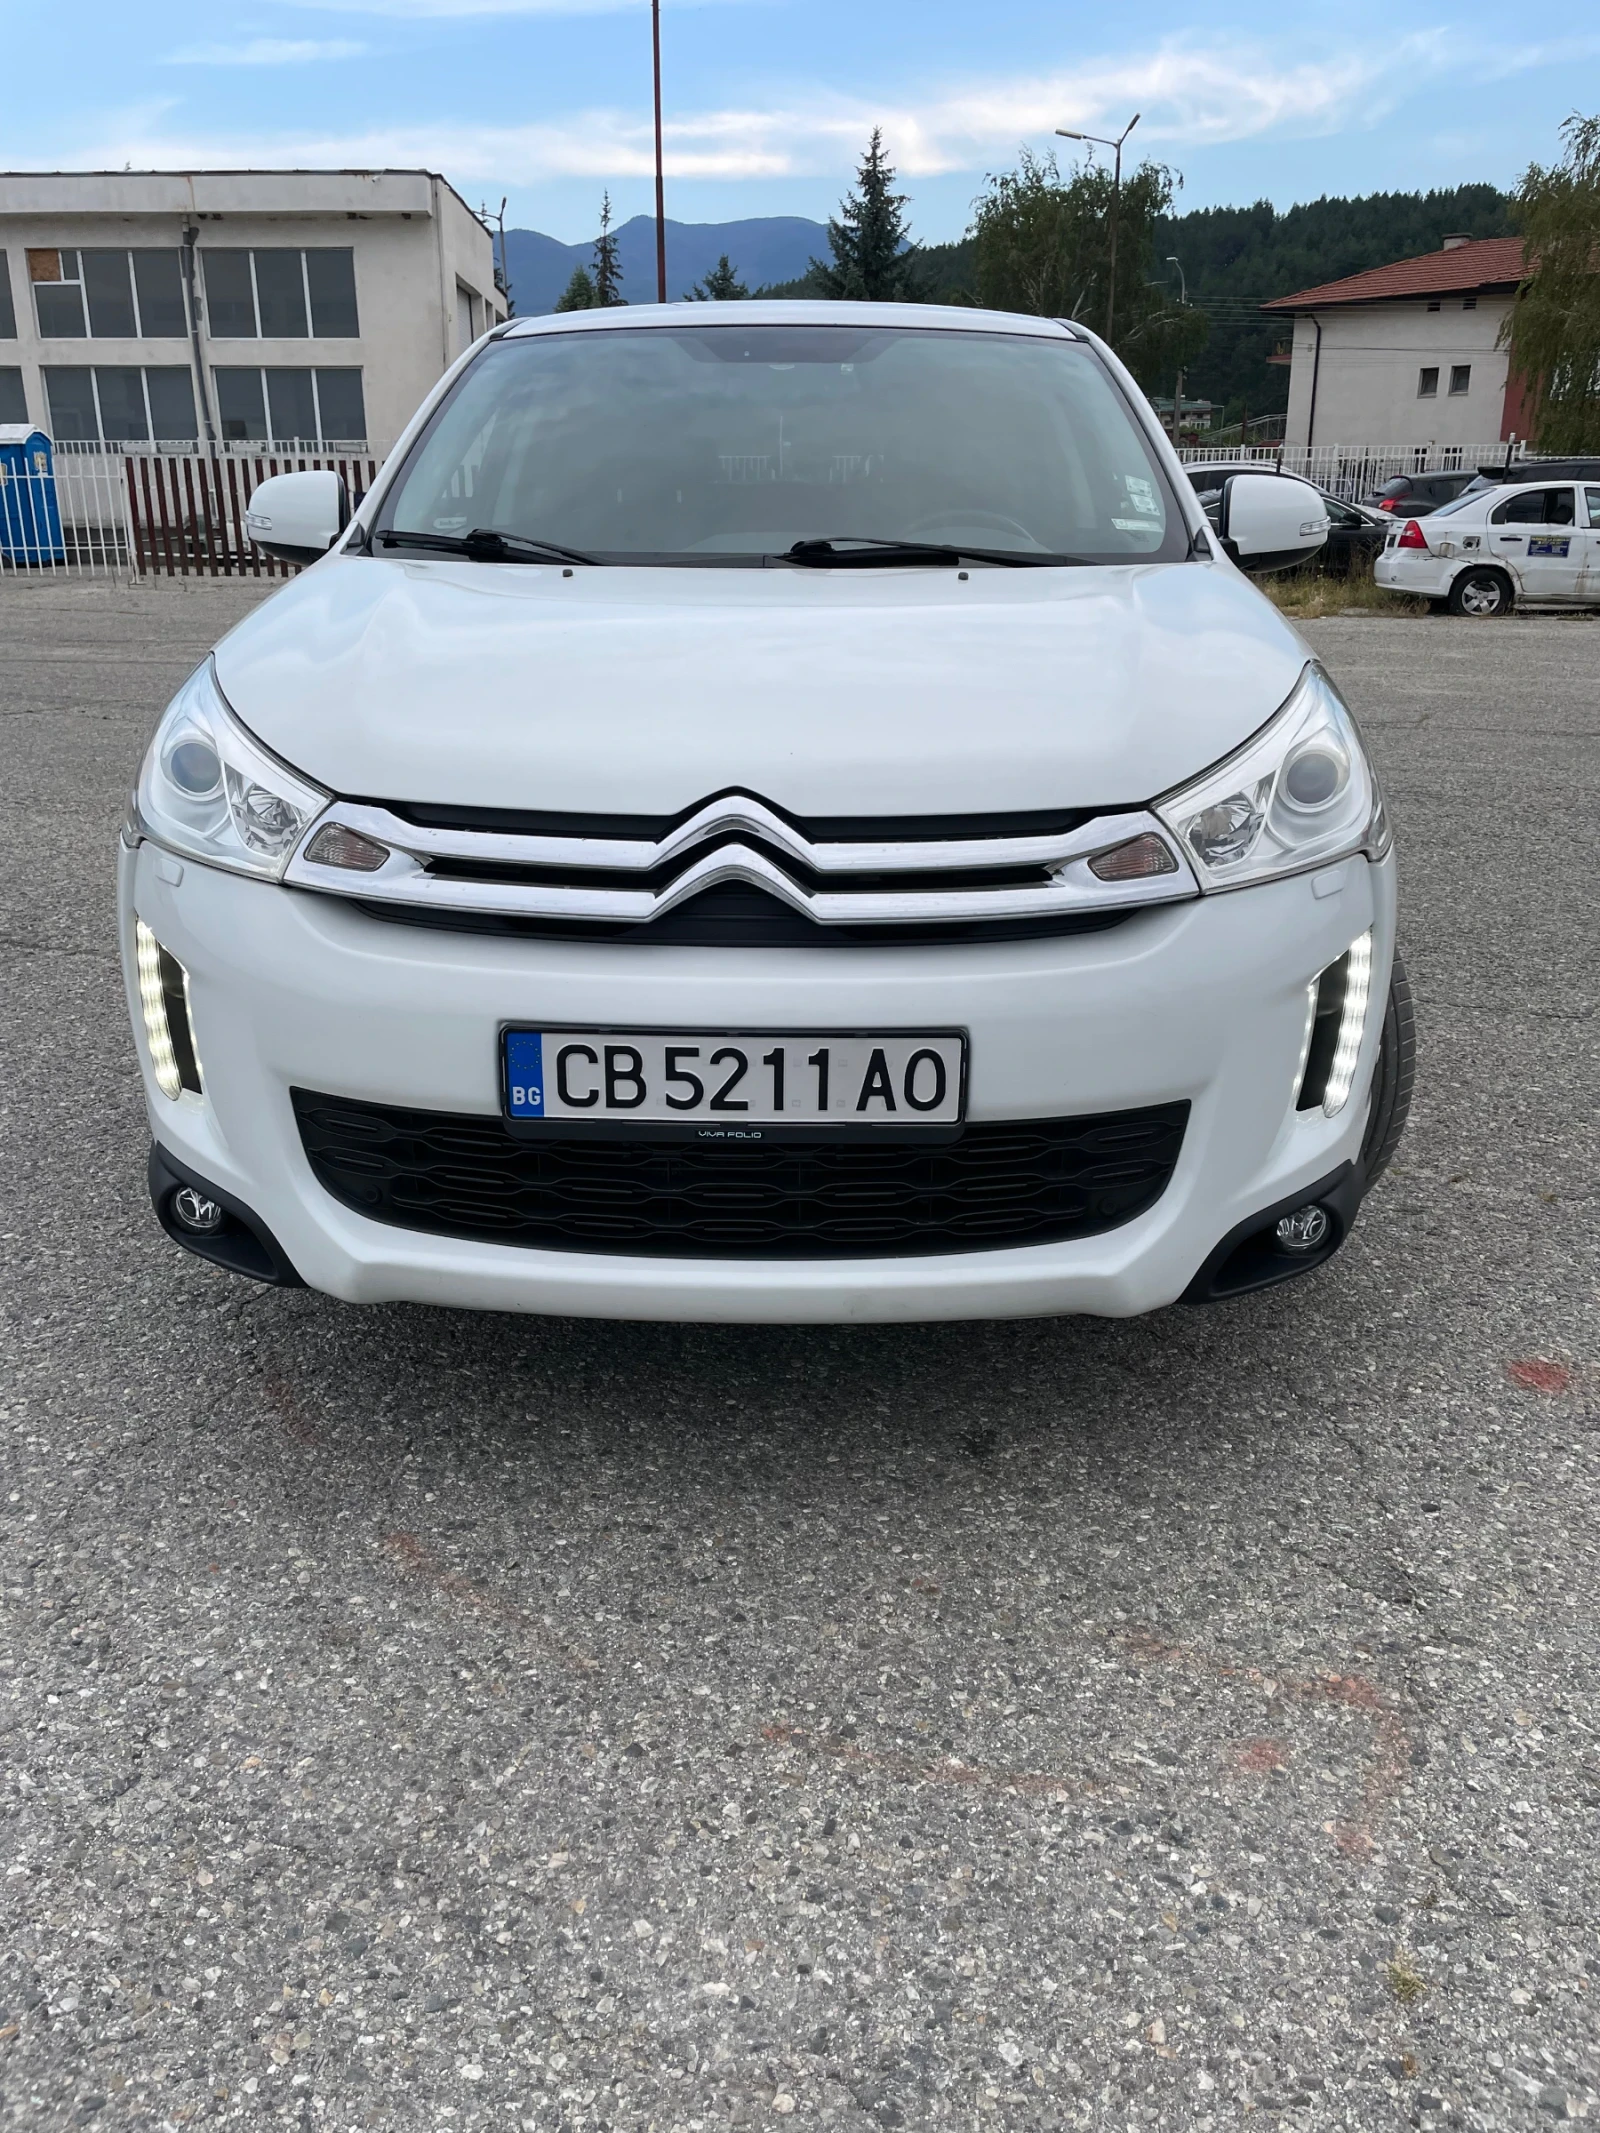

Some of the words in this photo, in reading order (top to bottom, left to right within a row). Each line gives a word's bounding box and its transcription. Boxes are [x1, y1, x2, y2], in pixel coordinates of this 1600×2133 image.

[512, 1086, 541, 1106] BG
[698, 1130, 725, 1138] VIVA
[727, 1131, 762, 1139] FOLIO
